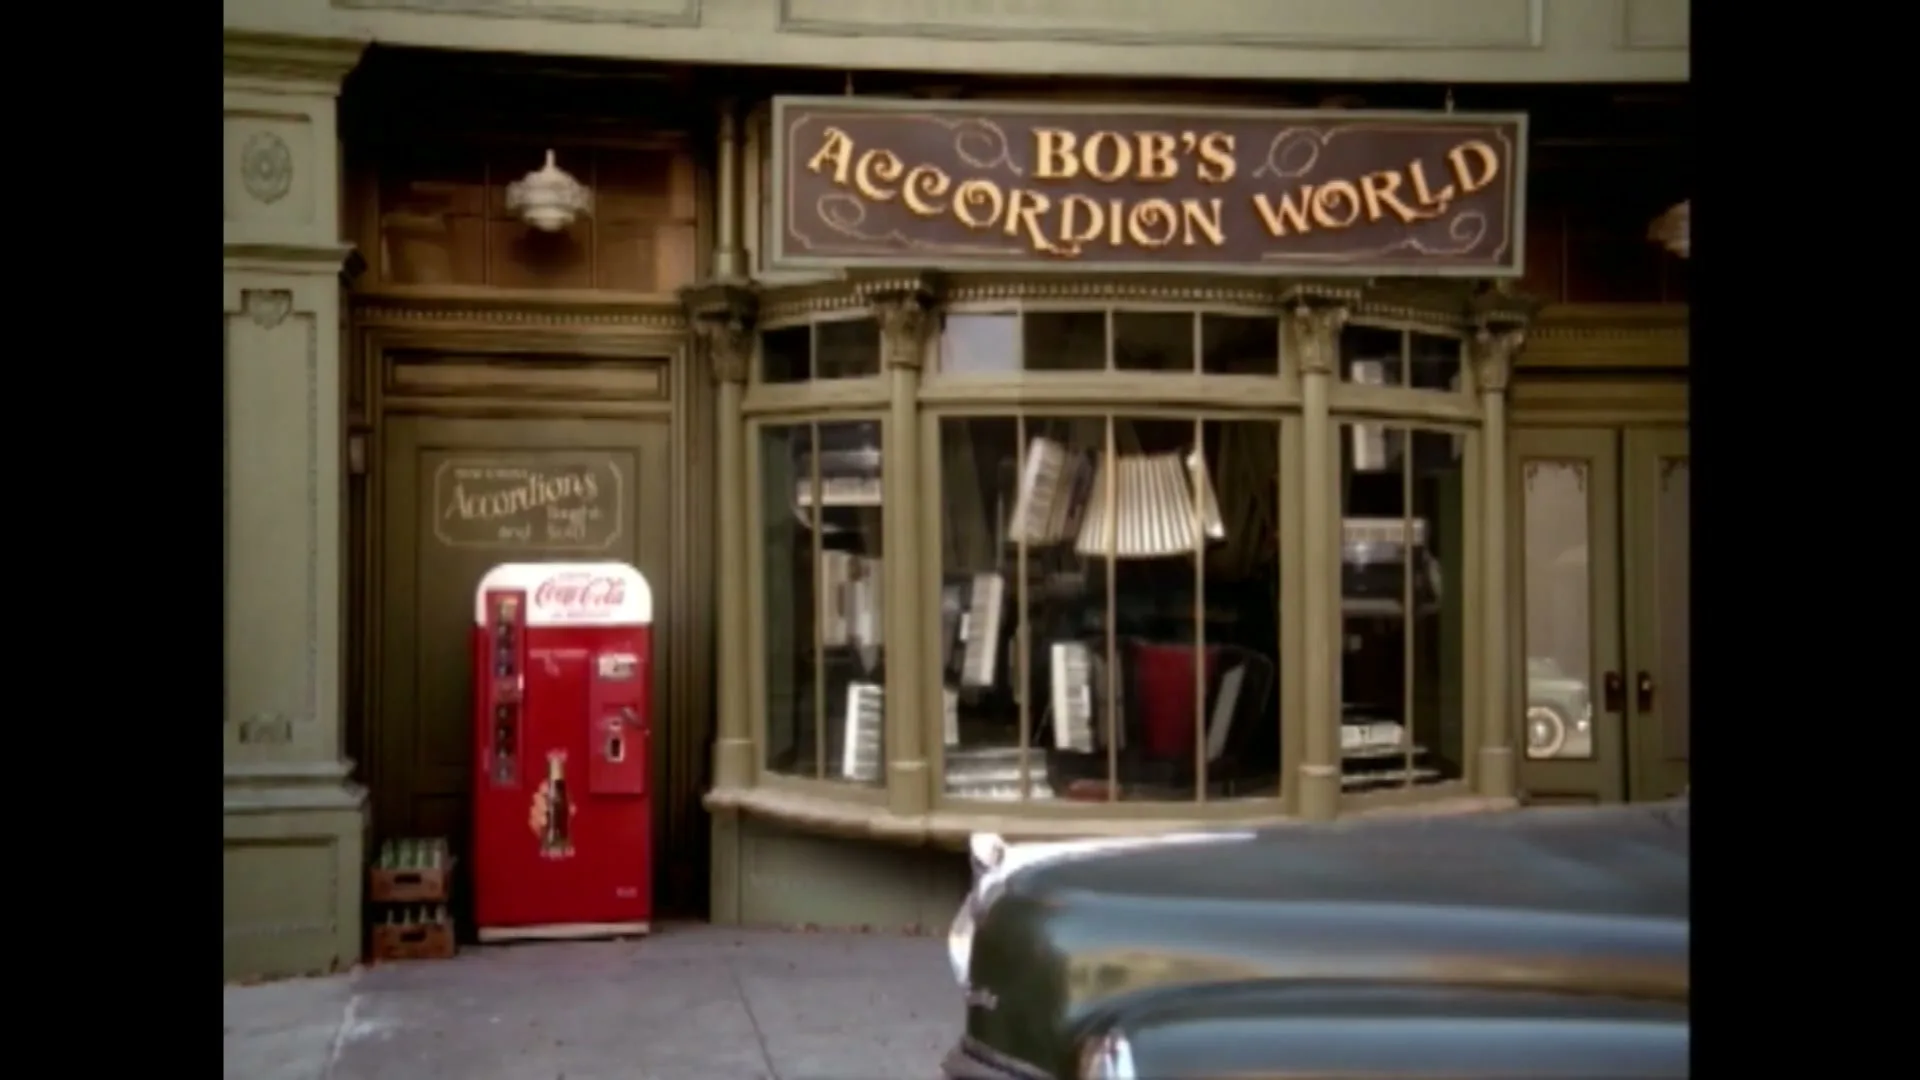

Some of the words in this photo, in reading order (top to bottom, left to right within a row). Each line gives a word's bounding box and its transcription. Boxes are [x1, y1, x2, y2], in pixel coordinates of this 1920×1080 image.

[1034, 129, 1236, 183] BOB'S
[807, 125, 1227, 255] ACCORDION
[1253, 139, 1501, 238] WORLD
[445, 472, 598, 520] Accordions
